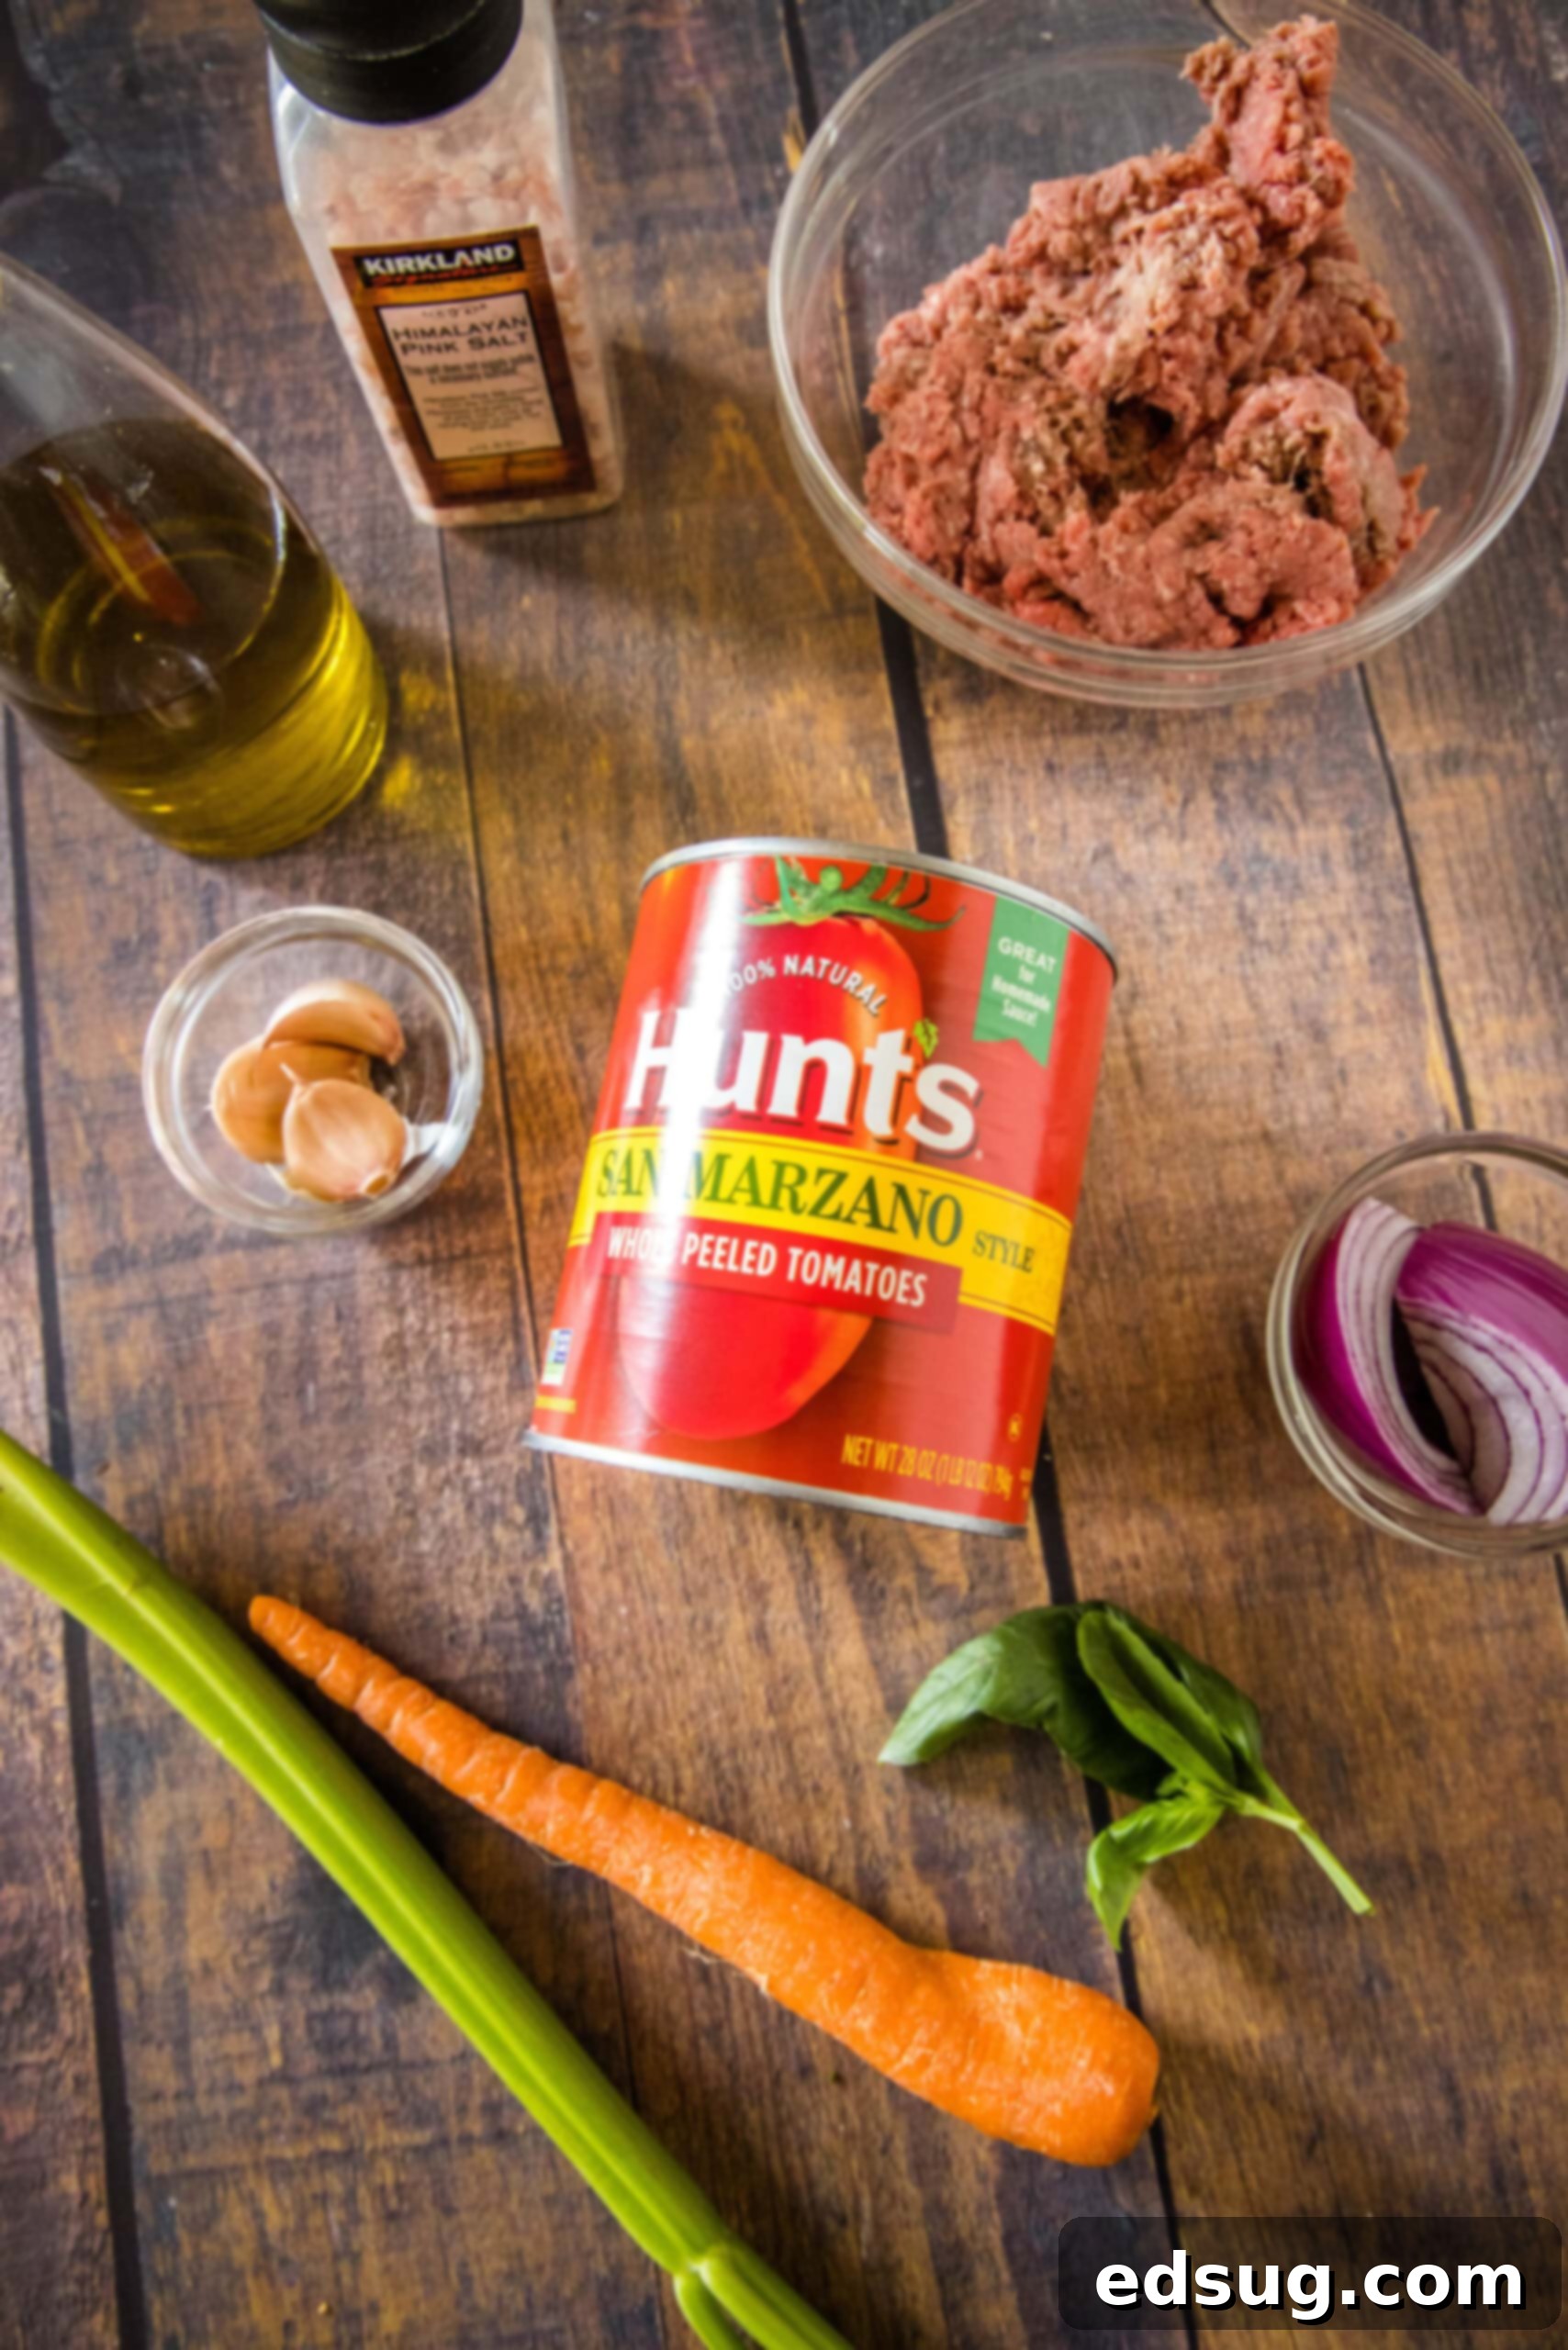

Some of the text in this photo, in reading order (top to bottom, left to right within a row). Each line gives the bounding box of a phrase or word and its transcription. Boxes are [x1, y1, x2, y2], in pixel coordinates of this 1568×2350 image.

[364, 243, 515, 275] KIRKLAND
[392, 316, 528, 341] HIMALAYAN
[400, 331, 528, 355] PINK SALT
[997, 935, 1057, 974] GREAT
[728, 954, 887, 1016] 00% NATURAL
[598, 1148, 1036, 1273] SAN MARZANO STYLE
[607, 1225, 928, 1308] WHO PEELED TOMATOES
[841, 1434, 873, 1467] NET
[874, 1439, 899, 1472] WT
